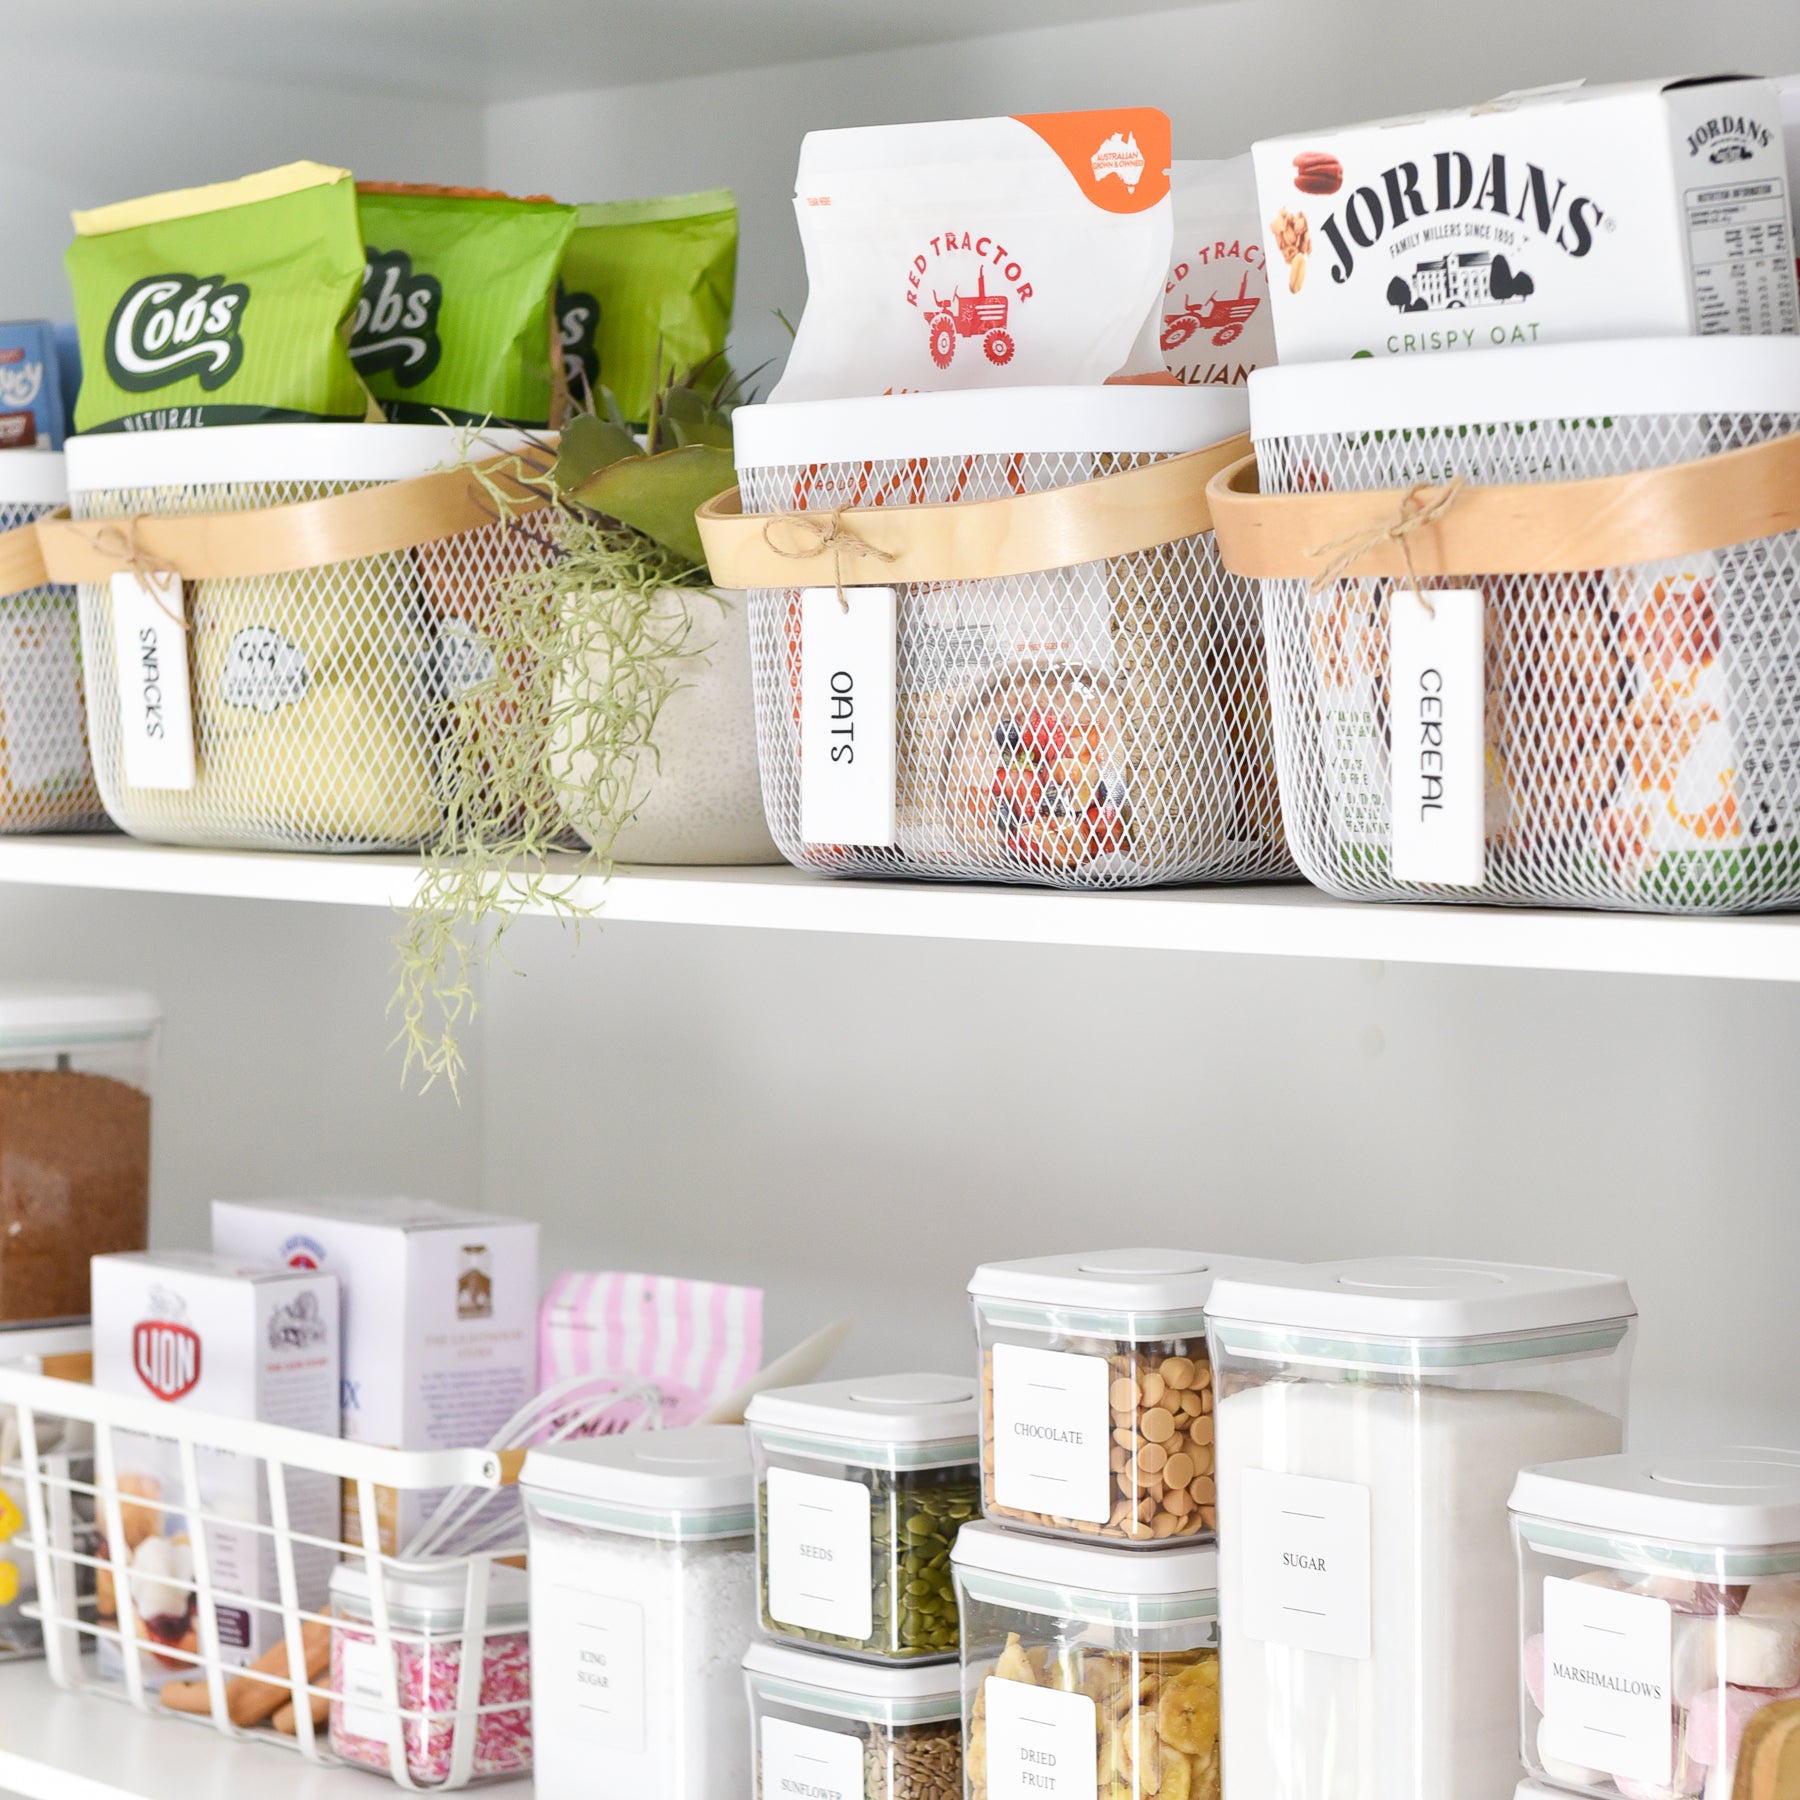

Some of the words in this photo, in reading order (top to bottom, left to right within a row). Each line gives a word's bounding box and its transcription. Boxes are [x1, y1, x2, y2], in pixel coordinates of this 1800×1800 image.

[1687, 116, 1772, 156] JORDANS
[1097, 151, 1138, 161] AUSTRALIAN
[1320, 151, 1604, 284] JORDANS
[1389, 231, 1421, 258] FAMILY
[1422, 222, 1461, 242] MILLERS
[1464, 222, 1492, 241] SINCE
[906, 254, 927, 307] RED
[930, 231, 1033, 303] TRACTOR
[1165, 262, 1189, 294] ED
[1199, 239, 1268, 284] TRACT
[349, 264, 432, 367] obs
[1387, 328, 1476, 353] CRISPY
[1490, 322, 1541, 344] OAT
[1166, 362, 1257, 386] ALIAN
[123, 406, 204, 432] NATURAL
[139, 627, 164, 740] SNACKS
[830, 671, 854, 764] OATS
[1419, 668, 1443, 822] CEREAL
[139, 1326, 196, 1395] LION
[1014, 1422, 1084, 1445] CHOCOLATE
[799, 1544, 833, 1562] SEEDS
[1283, 1552, 1326, 1572] SUGAR
[580, 1650, 607, 1667] ICING
[577, 1670, 610, 1688] SUGAR
[1552, 1661, 1662, 1700] MARSHMALLOWS
[1020, 1747, 1057, 1767] DRIED
[781, 1778, 842, 1800] SUNFLOWER
[1022, 1771, 1056, 1790] FRUIT
